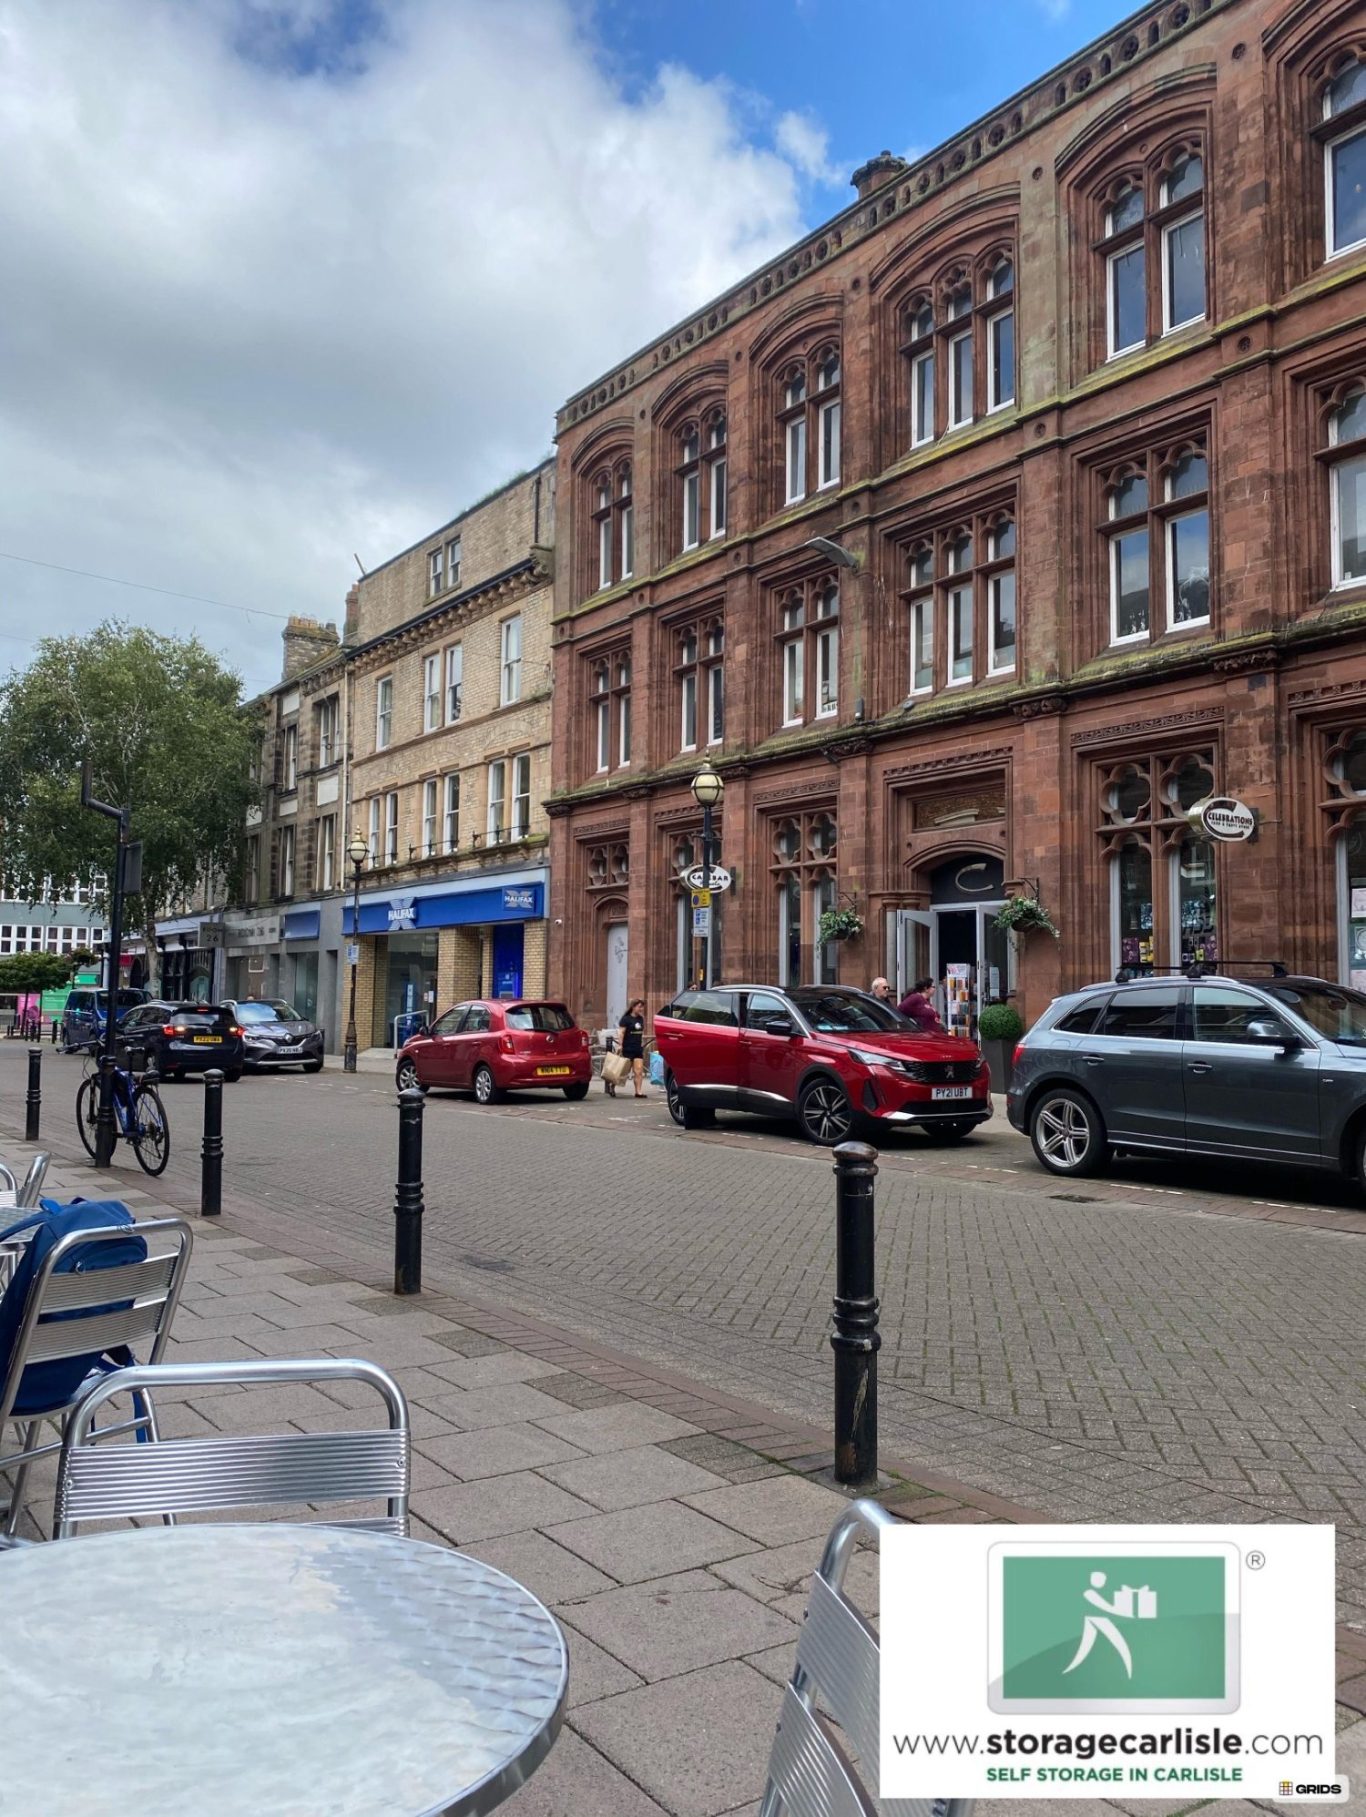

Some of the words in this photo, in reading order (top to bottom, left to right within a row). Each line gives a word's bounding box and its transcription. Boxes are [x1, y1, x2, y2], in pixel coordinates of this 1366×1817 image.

[1207, 812, 1253, 825] CELEBRATIONS
[504, 895, 533, 903] HALIFAX
[388, 907, 414, 921] HALIFAX
